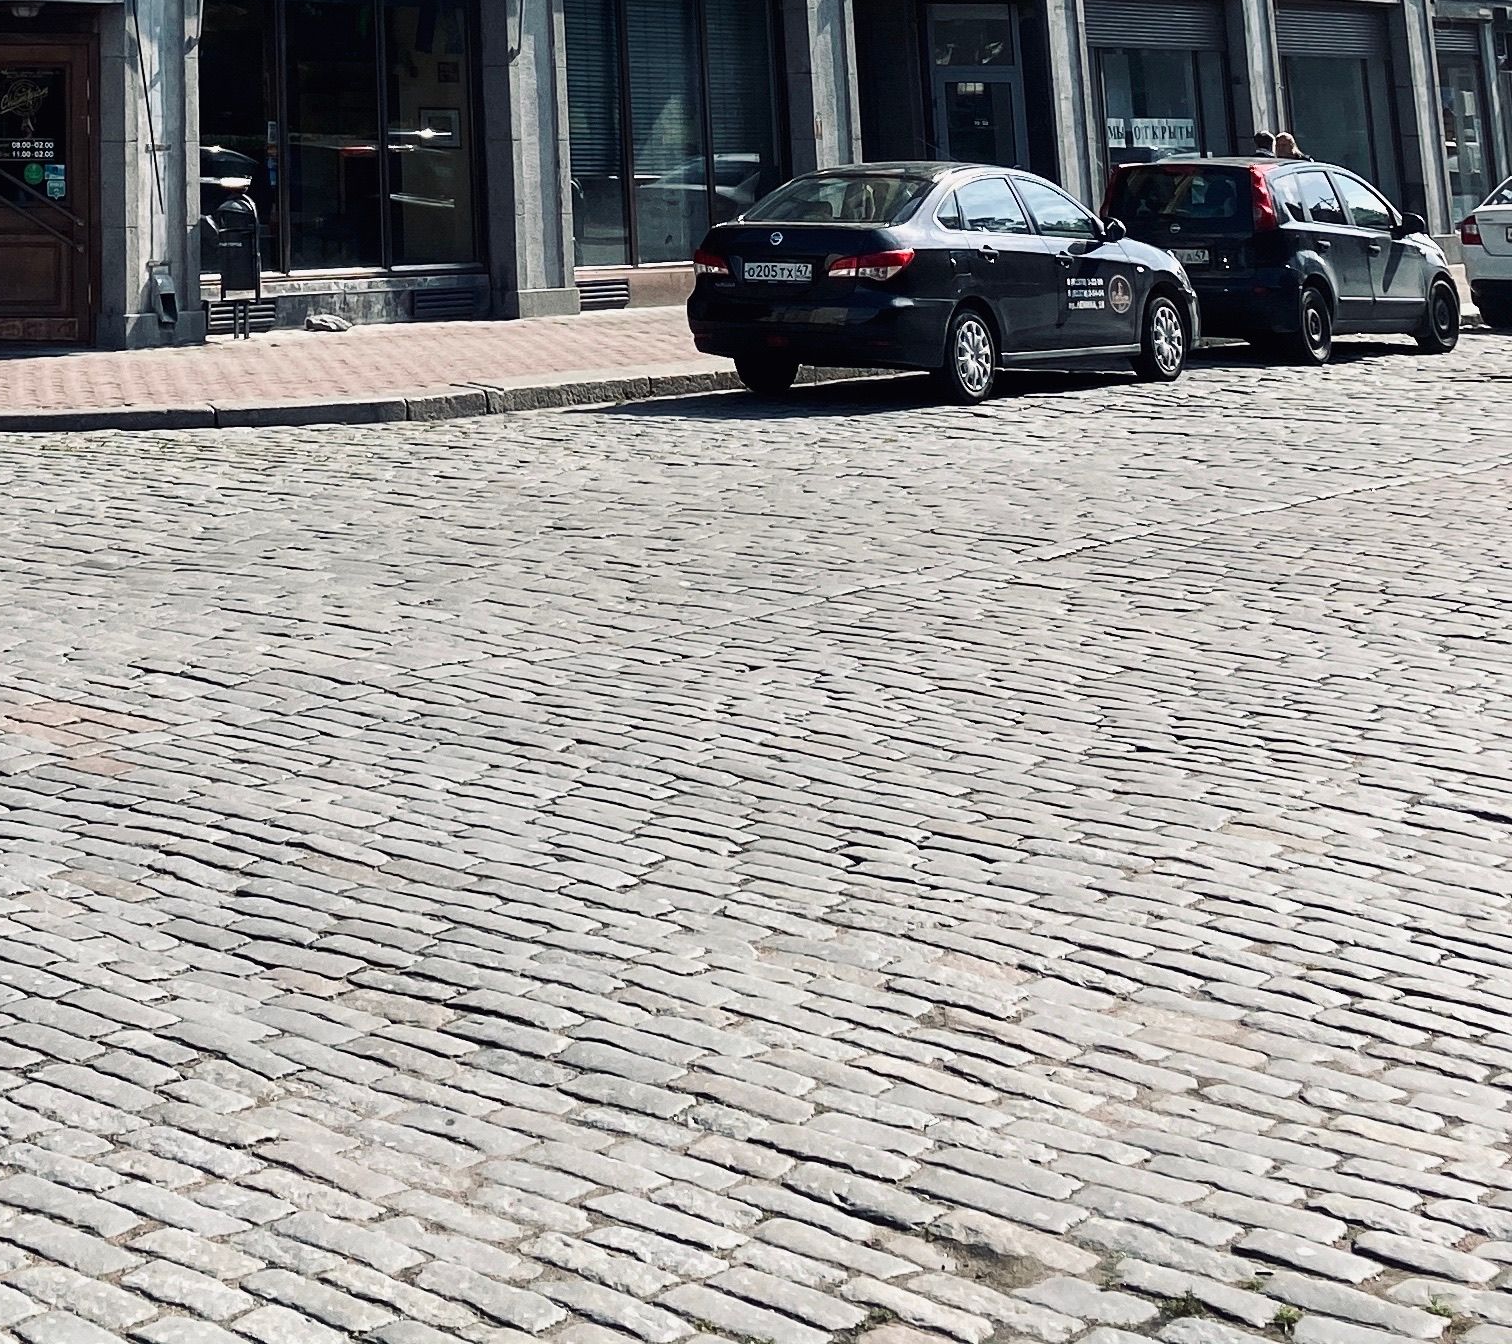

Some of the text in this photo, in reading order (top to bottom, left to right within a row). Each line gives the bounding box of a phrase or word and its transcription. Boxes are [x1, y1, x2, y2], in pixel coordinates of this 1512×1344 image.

[1134, 125, 1194, 141] ОТКРЫТЫ
[747, 264, 809, 279] О205ТХ 47
